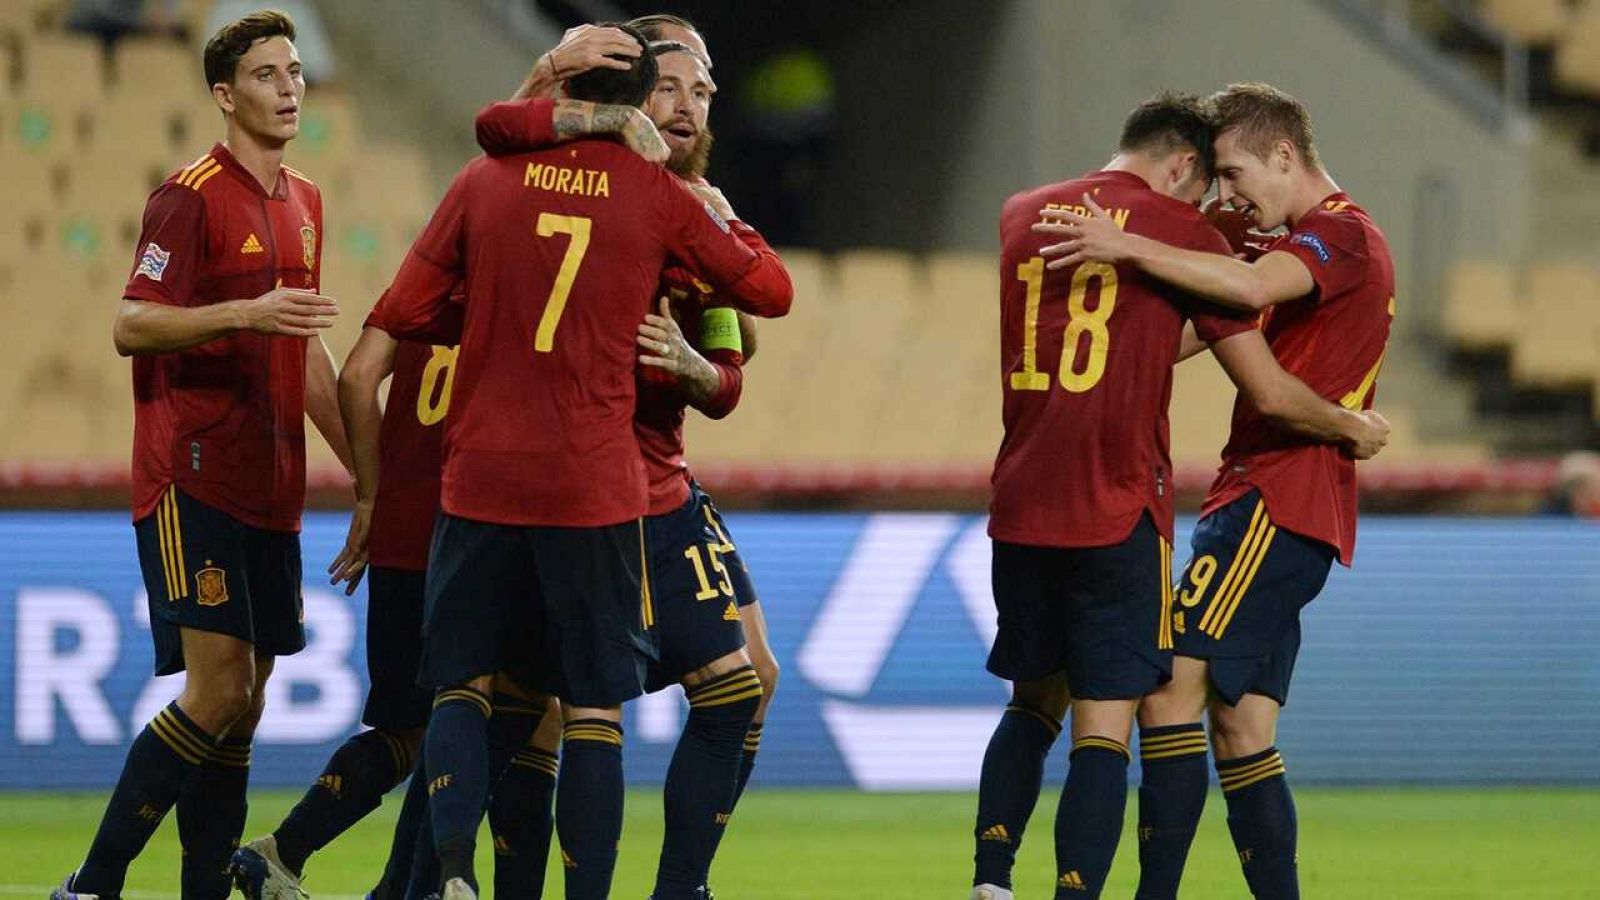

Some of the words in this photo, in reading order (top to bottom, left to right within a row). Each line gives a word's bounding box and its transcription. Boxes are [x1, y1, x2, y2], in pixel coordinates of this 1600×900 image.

[524, 162, 610, 198] MORATA
[535, 212, 592, 352] 7
[1010, 256, 1118, 393] 18
[684, 543, 736, 601] 15
[1173, 554, 1218, 608] 9
